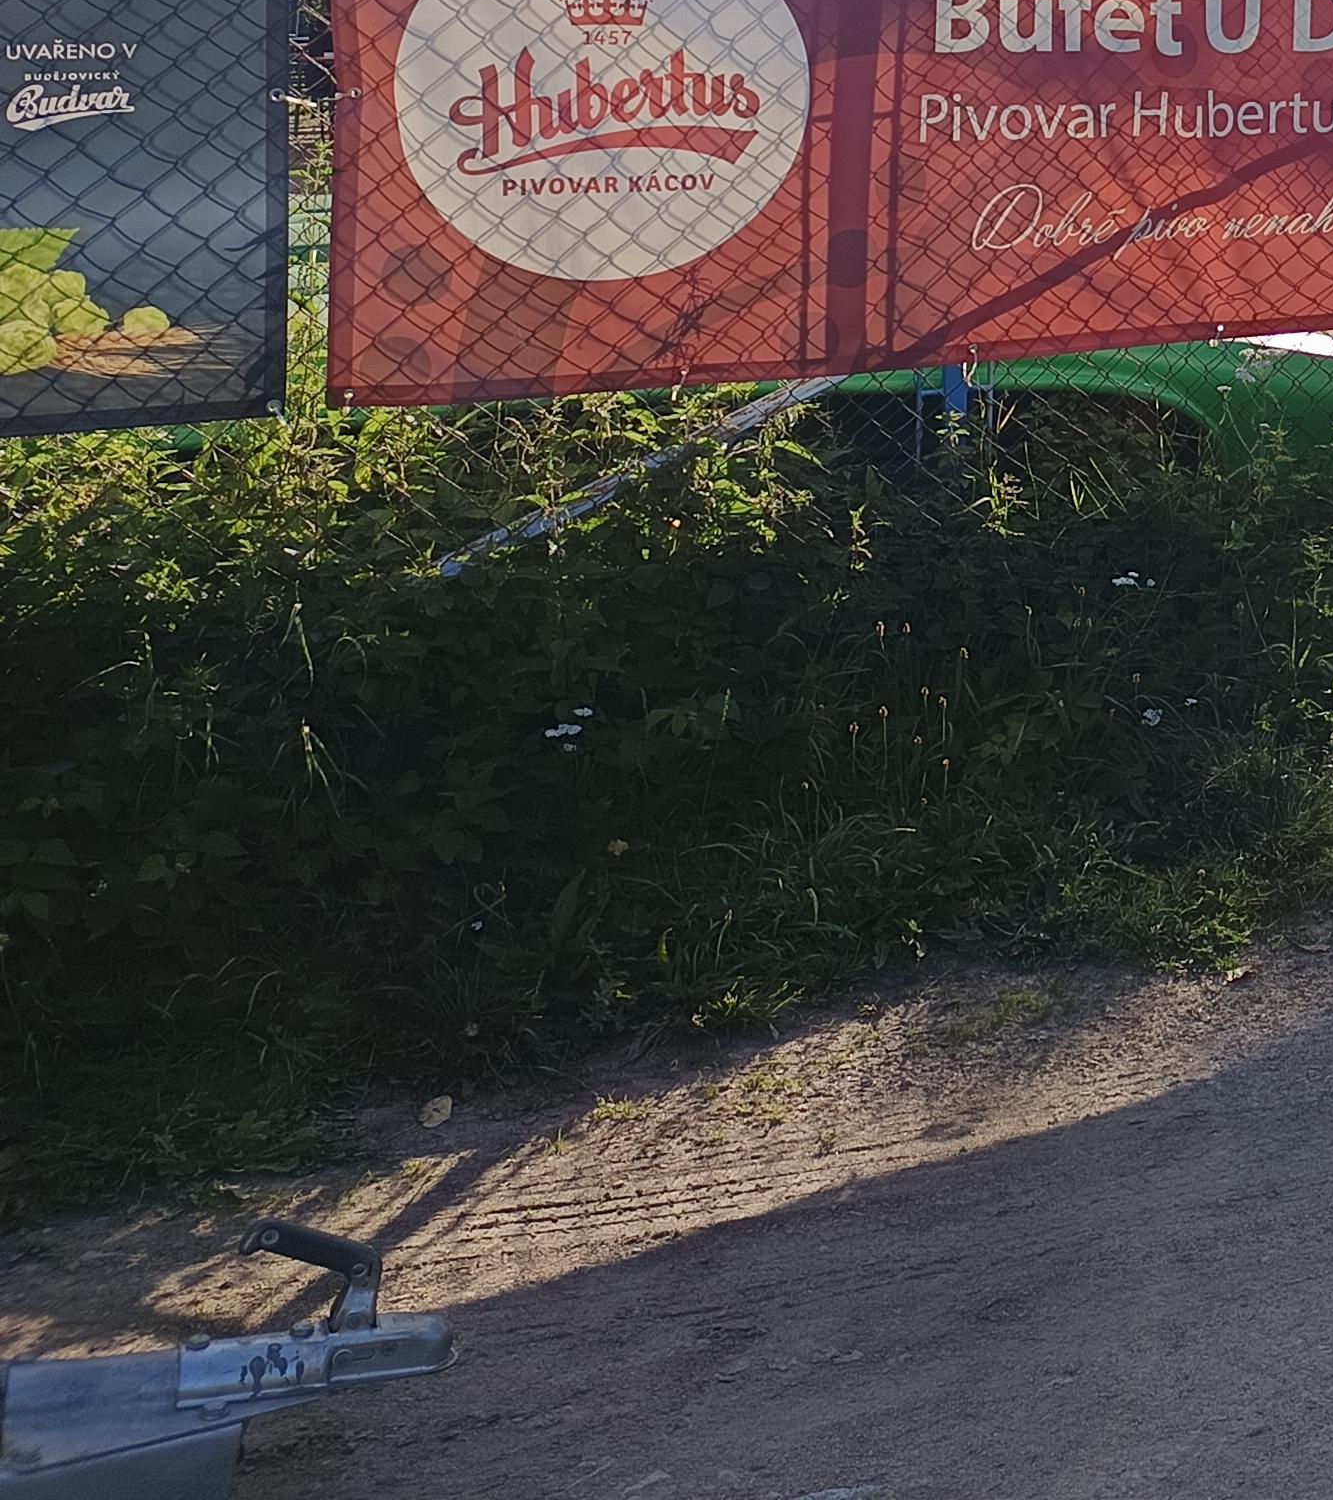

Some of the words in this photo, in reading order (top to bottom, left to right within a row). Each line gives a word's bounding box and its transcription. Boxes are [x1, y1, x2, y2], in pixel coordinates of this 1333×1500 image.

[6, 39, 116, 60] UVAŘENO
[121, 43, 138, 59] V
[582, 30, 633, 45] 1457
[24, 70, 120, 81] BUDĚJOVICKÝ
[6, 84, 135, 124] Budvar
[449, 46, 760, 160] Hubertus
[919, 93, 1117, 143] Pivovar
[502, 176, 618, 197] PIVOVAR
[628, 170, 715, 193] KÁCOV
[971, 184, 1127, 251] Dobré
[1113, 203, 1211, 261] pivo
